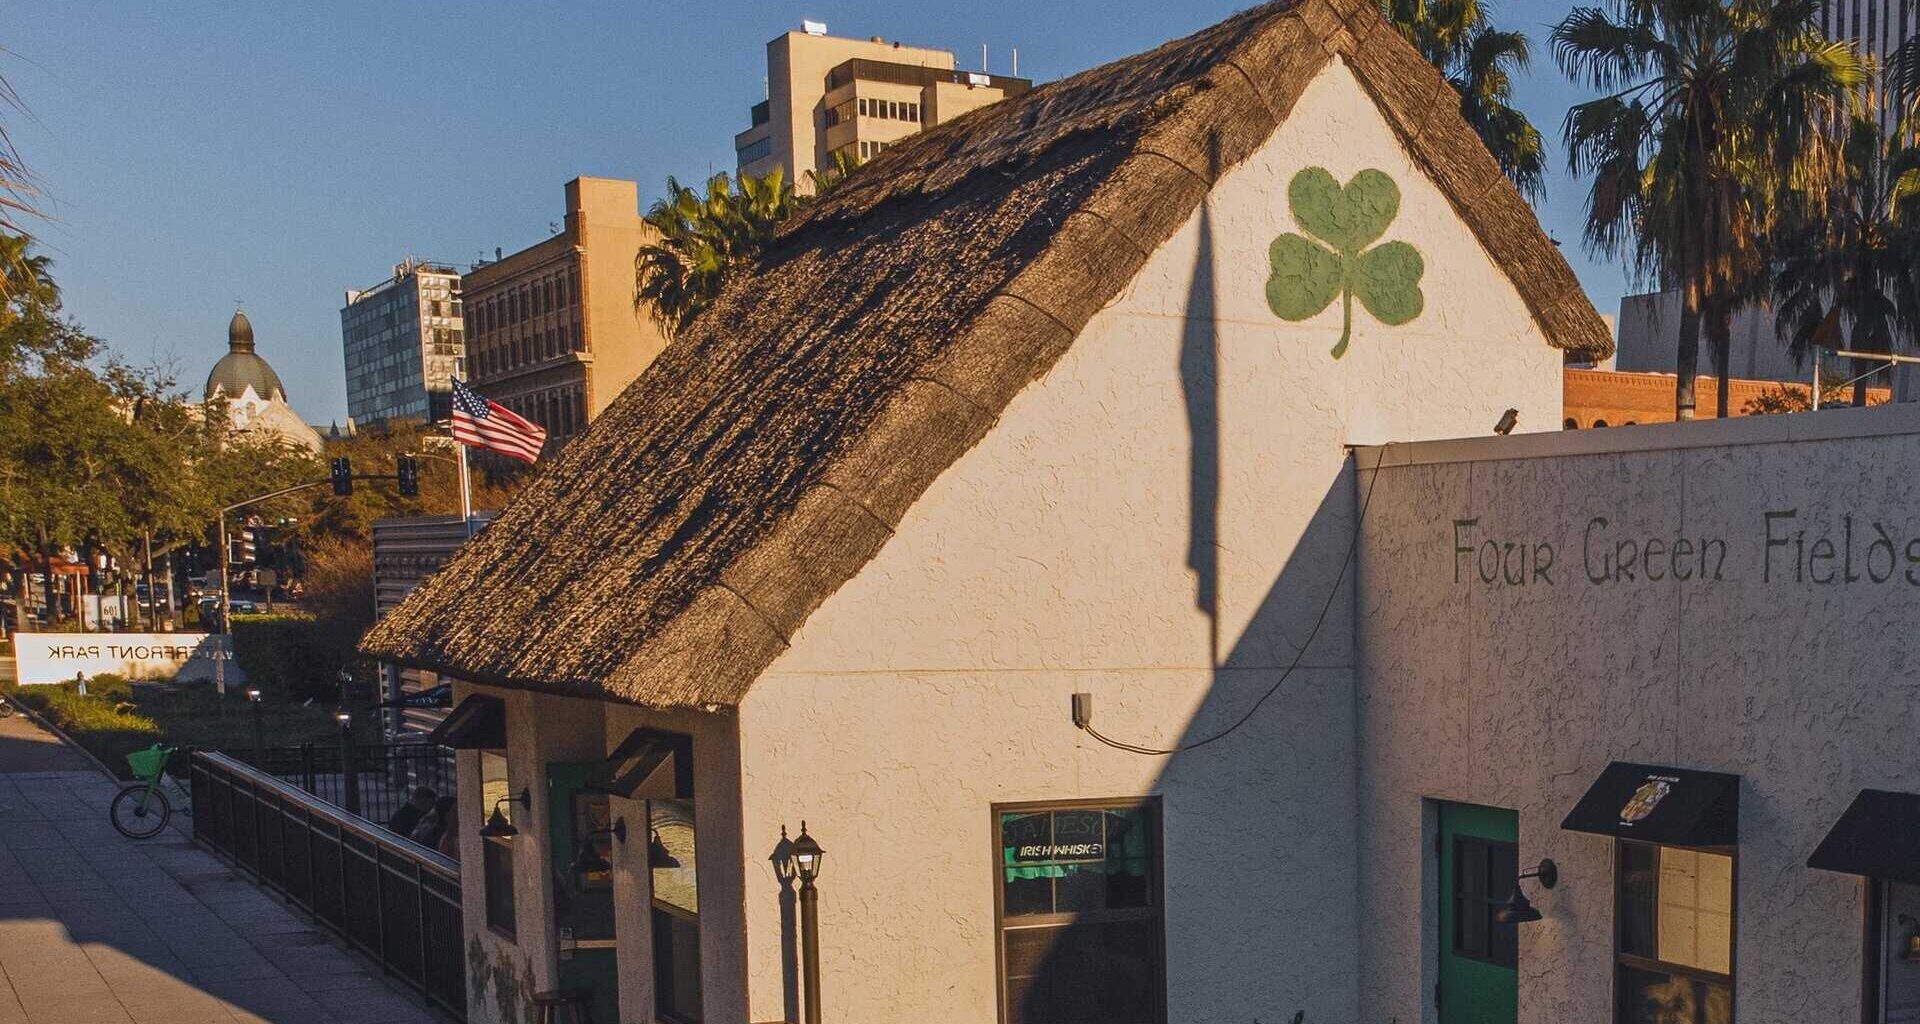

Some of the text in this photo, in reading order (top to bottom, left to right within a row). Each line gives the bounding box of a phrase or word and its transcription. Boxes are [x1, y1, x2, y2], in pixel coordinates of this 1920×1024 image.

[1452, 508, 1920, 587] Four Green Fields
[103, 604, 118, 617] 601
[1020, 845, 1052, 857] IRISH
